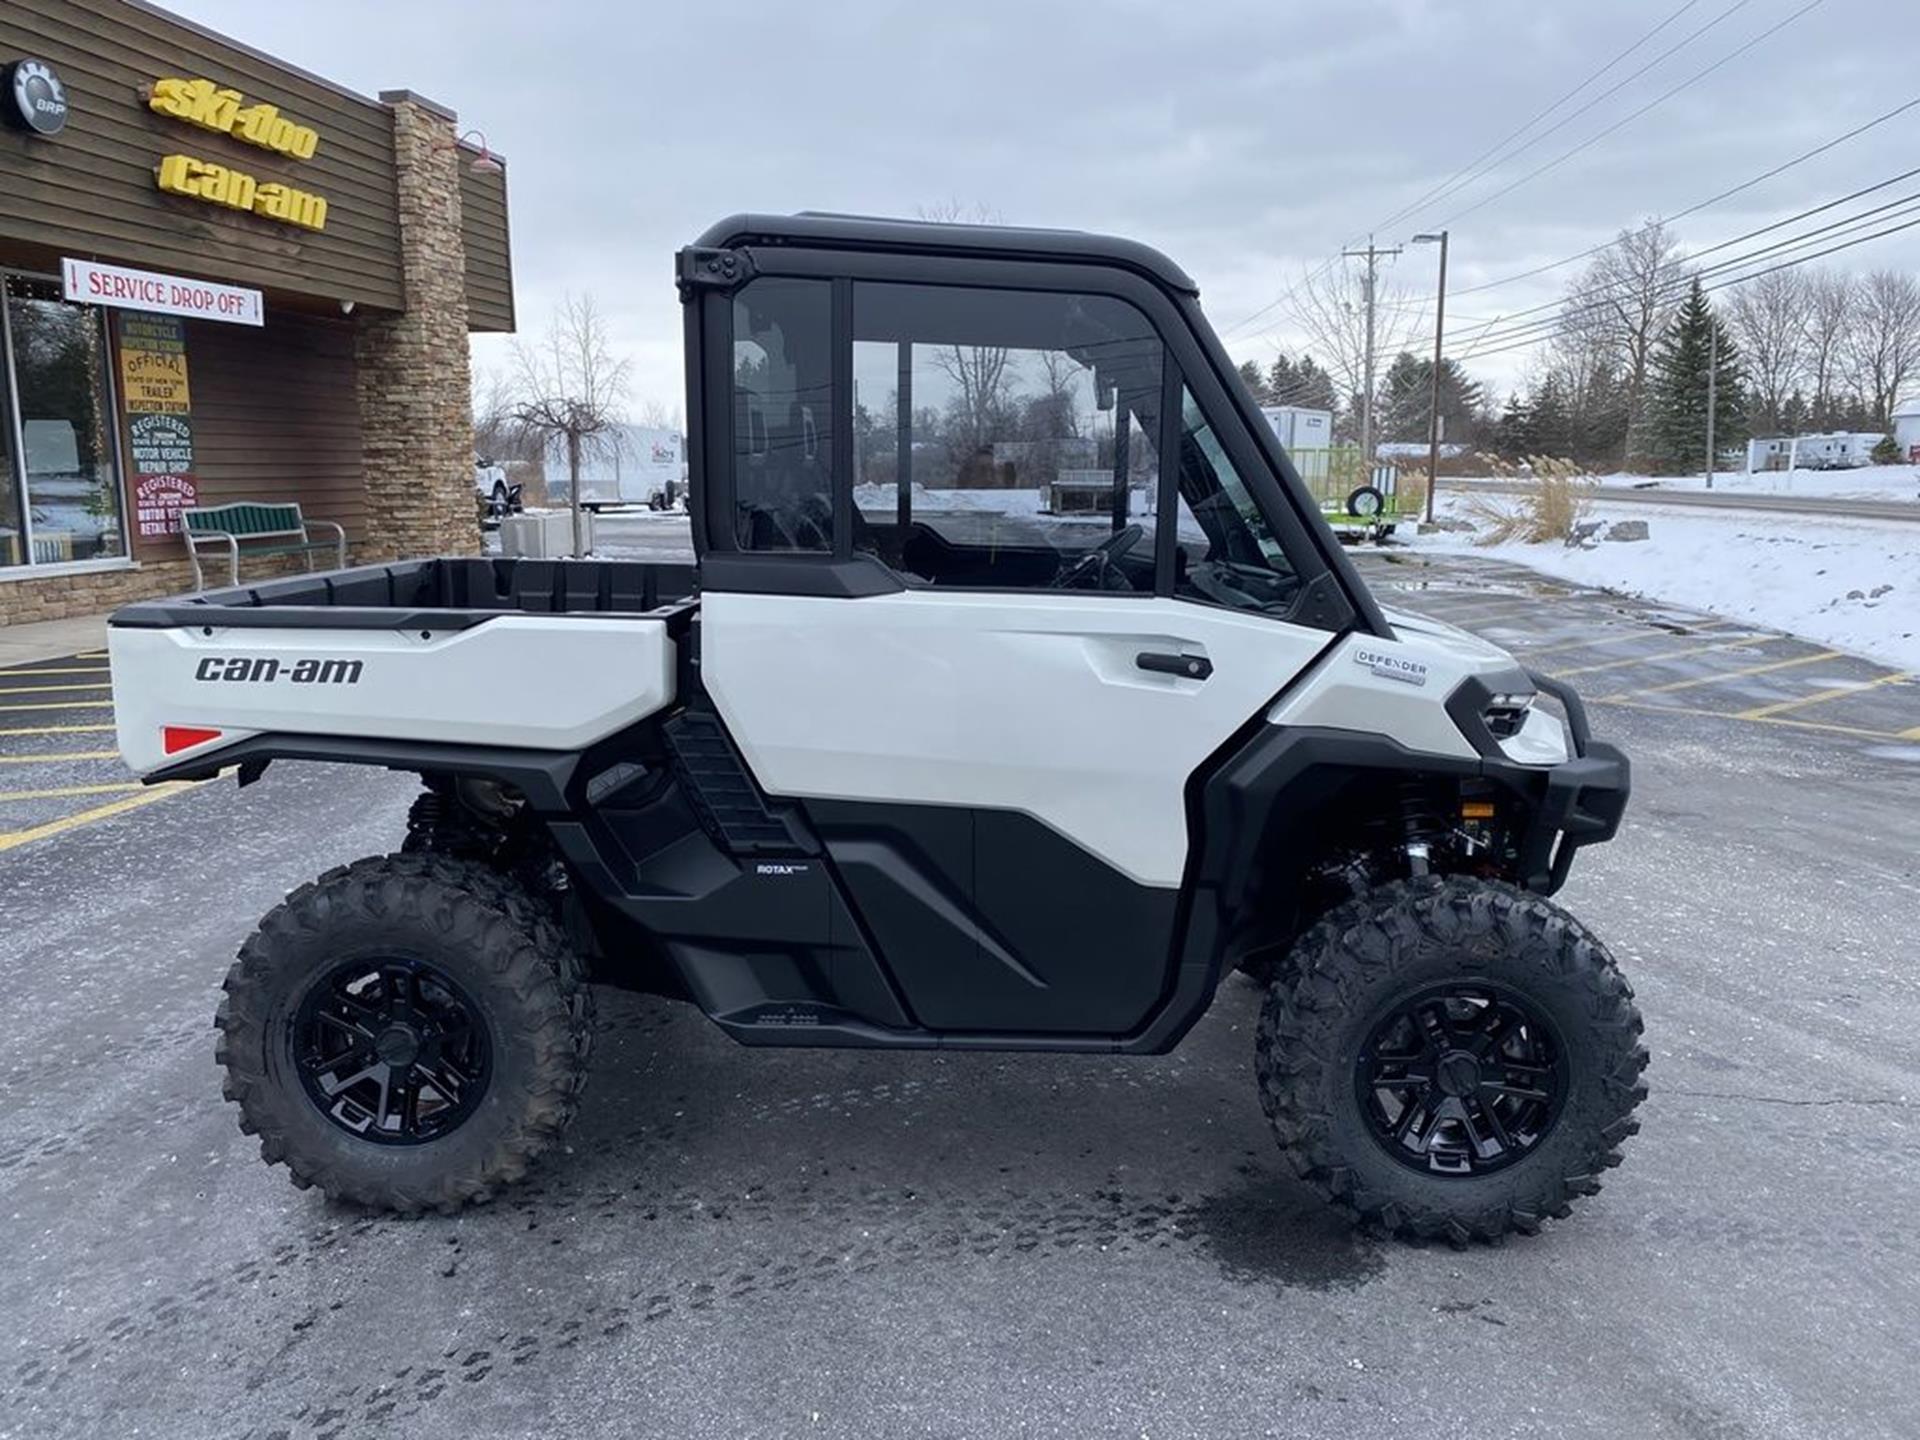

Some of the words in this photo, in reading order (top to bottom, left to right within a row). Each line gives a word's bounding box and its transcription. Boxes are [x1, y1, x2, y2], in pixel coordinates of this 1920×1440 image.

[36, 98, 66, 114] BRP
[150, 77, 319, 160] ski-doo
[158, 154, 327, 231] can-am
[88, 271, 166, 305] SERVICE
[171, 284, 214, 310] DROP
[218, 293, 245, 316] OFF
[128, 355, 182, 376] OFFICIAL
[141, 385, 174, 399] TRAILER
[128, 400, 163, 412] INSPECTION
[164, 401, 188, 413] STATION
[131, 415, 191, 438] REGISTERED
[132, 447, 160, 460] MOTOR
[161, 448, 193, 461] VEHICLE
[139, 461, 168, 474] REPAIR
[168, 461, 190, 474] SHOP
[137, 475, 196, 499] REGISTERED
[138, 508, 166, 522] MOTOR
[195, 657, 363, 684] can-am
[1359, 651, 1427, 675] DEFENDER
[757, 864, 794, 875] ROTAX
